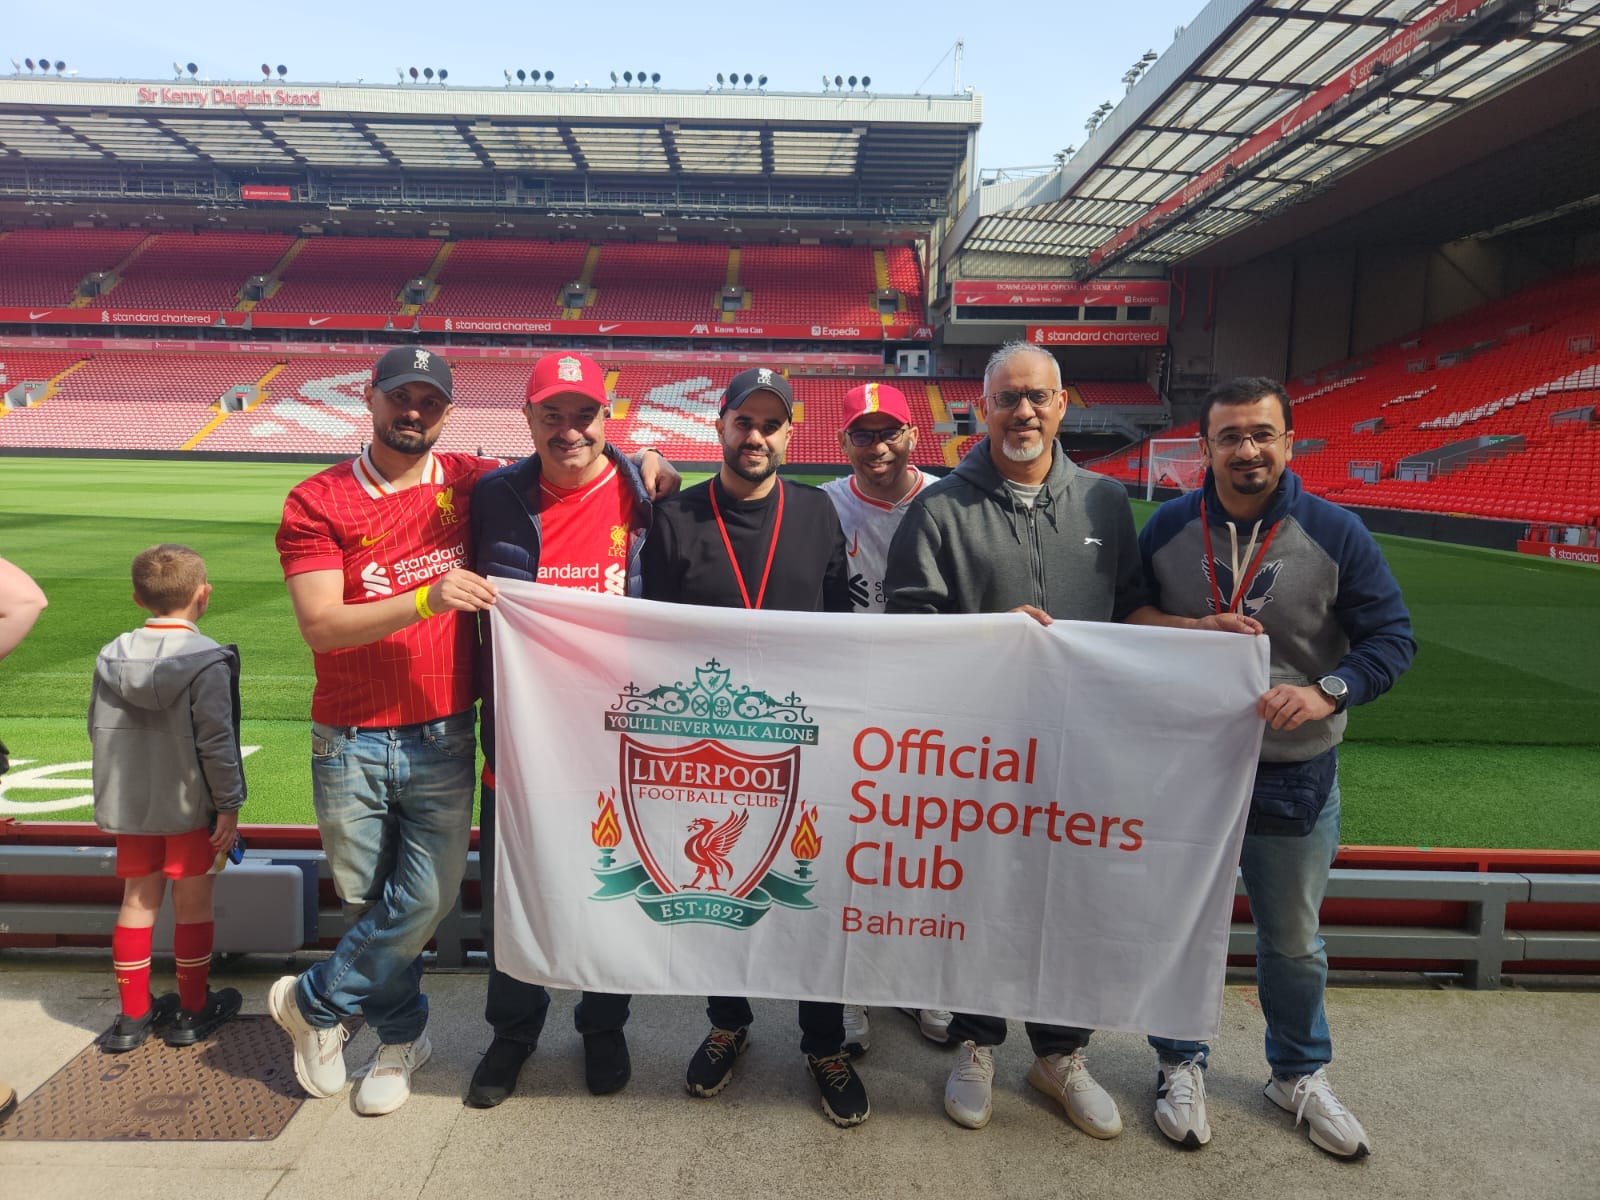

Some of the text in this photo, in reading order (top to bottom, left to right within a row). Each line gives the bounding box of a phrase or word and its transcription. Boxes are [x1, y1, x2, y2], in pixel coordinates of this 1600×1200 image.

[160, 87, 207, 107] Kenny
[212, 88, 272, 109] Dalglish
[275, 89, 320, 105] Stand
[112, 313, 211, 323] standard chartered
[455, 320, 551, 331] standard chartered
[690, 324, 710, 334] AXA
[822, 326, 860, 337] Expedia
[1047, 328, 1159, 341] standard chartered
[440, 514, 458, 527] LFC
[393, 541, 465, 575] standard
[608, 549, 626, 558] LFC
[1558, 549, 1599, 563] standard
[536, 563, 600, 579] andard
[608, 714, 815, 743] YOU'LL NEVER WALK ALONE
[852, 726, 1038, 784] Official
[632, 757, 787, 791] LIVERPOOL
[638, 786, 779, 808] FOOTBALL CLUB
[849, 779, 1145, 851] Supporters
[845, 841, 964, 891] Club
[841, 906, 966, 941] Bahrain
